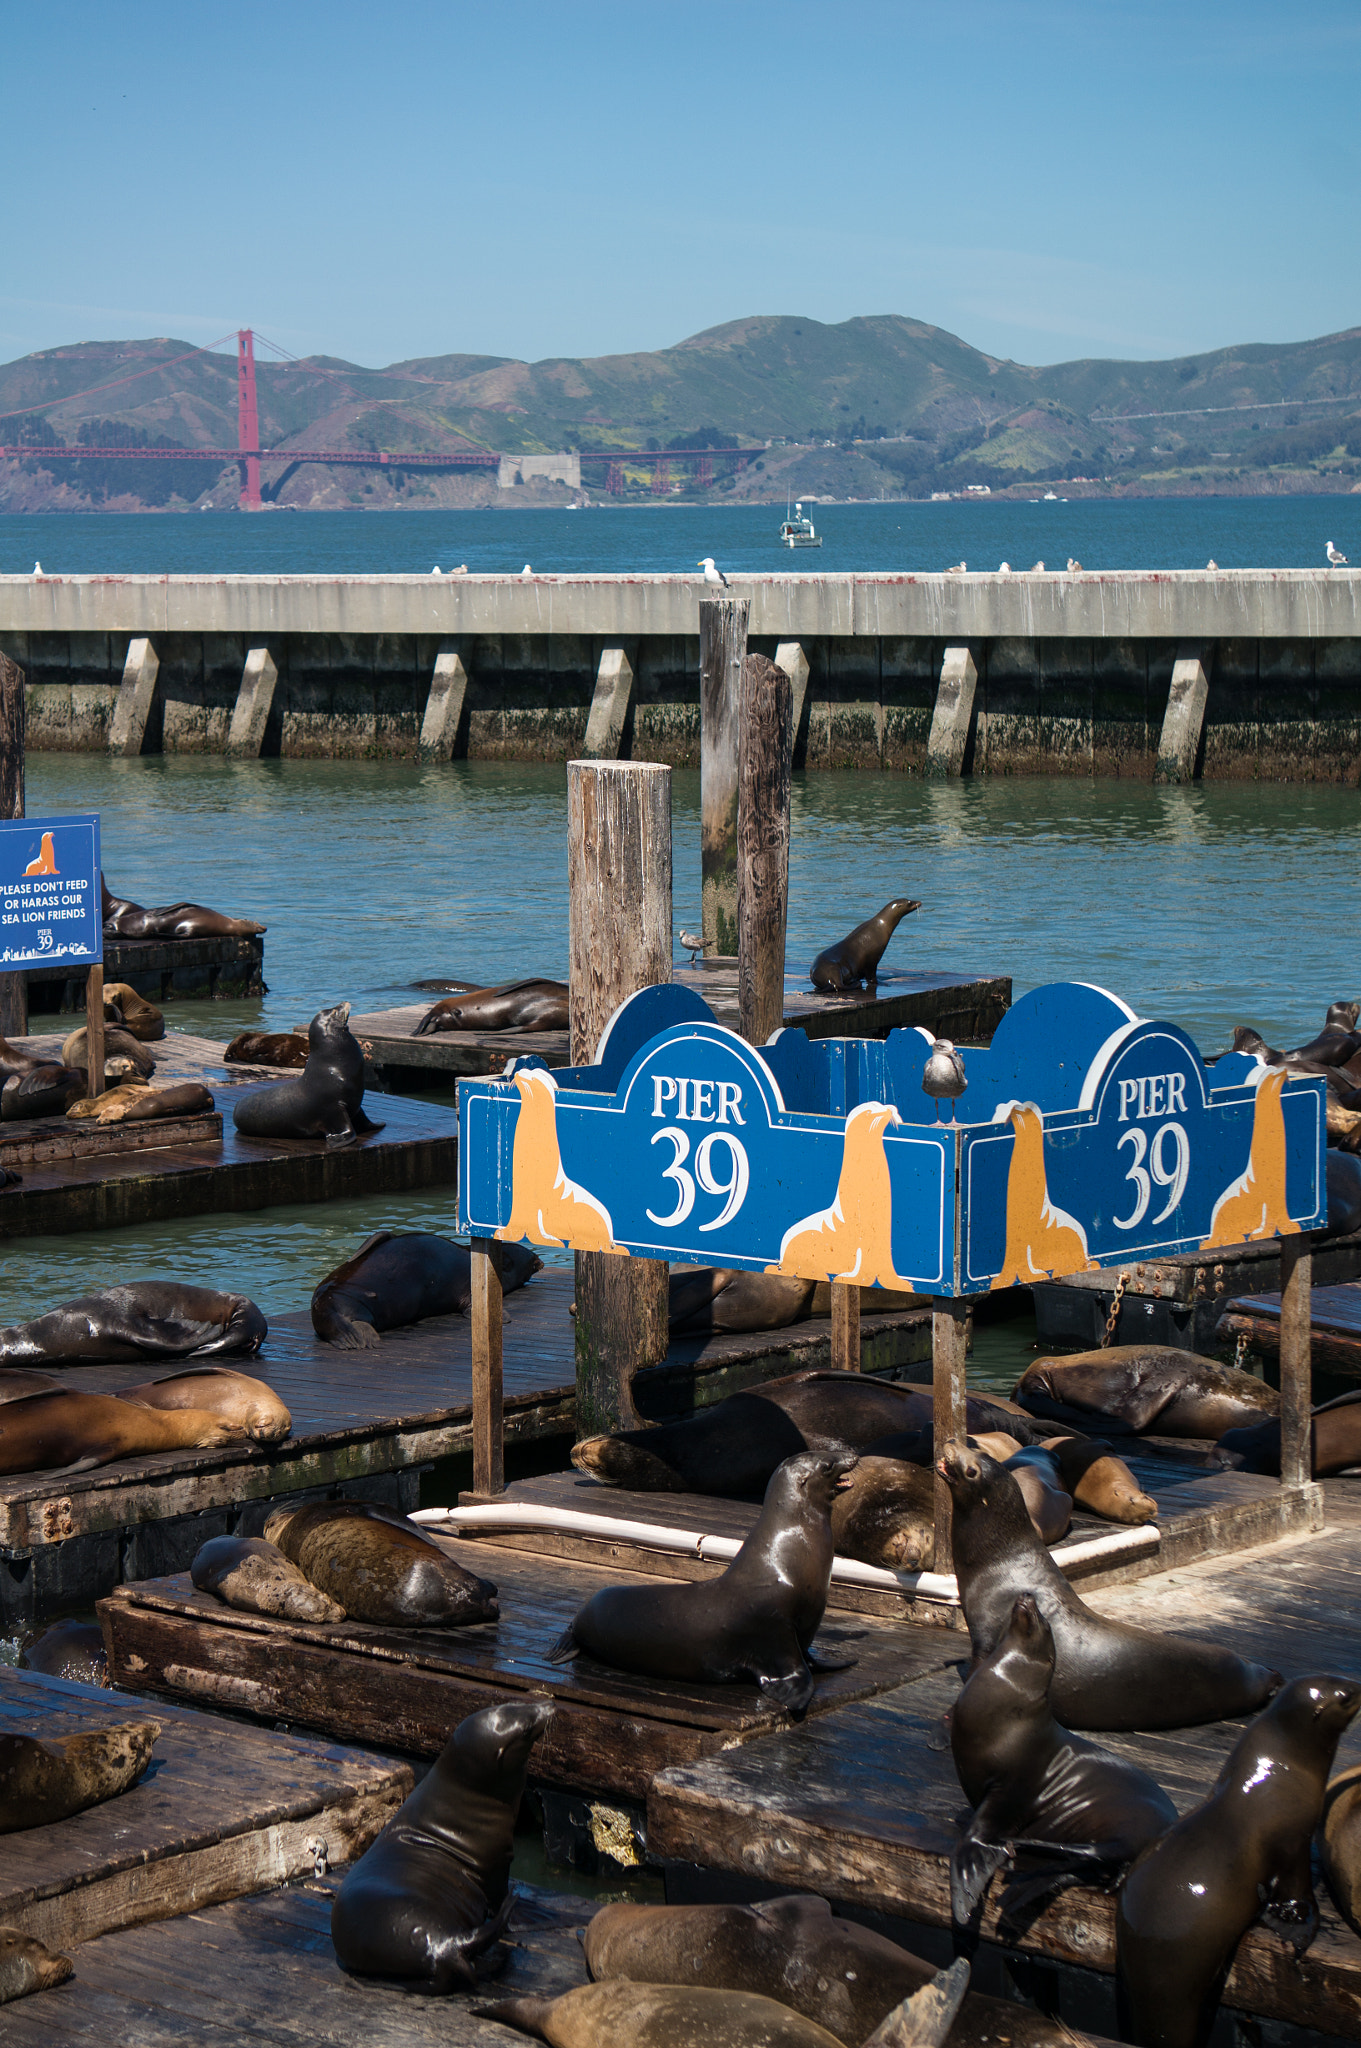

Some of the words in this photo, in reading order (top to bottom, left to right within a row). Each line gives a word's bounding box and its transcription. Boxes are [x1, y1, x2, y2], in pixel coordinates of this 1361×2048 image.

[0, 884, 31, 895] PLEASE
[34, 881, 63, 892] DON'T
[66, 880, 88, 890] FEED
[4, 900, 19, 909] OR
[21, 896, 59, 908] HARASS
[61, 894, 82, 905] OUR
[1, 914, 20, 924] SEA
[22, 912, 45, 922] LION
[48, 908, 85, 920] FRIENDS
[37, 928, 53, 936] PIER
[37, 935, 53, 951] 39
[650, 1075, 747, 1126] PIER
[1117, 1072, 1189, 1122] PIER
[645, 1126, 750, 1232] 39
[1112, 1121, 1190, 1230] 39
